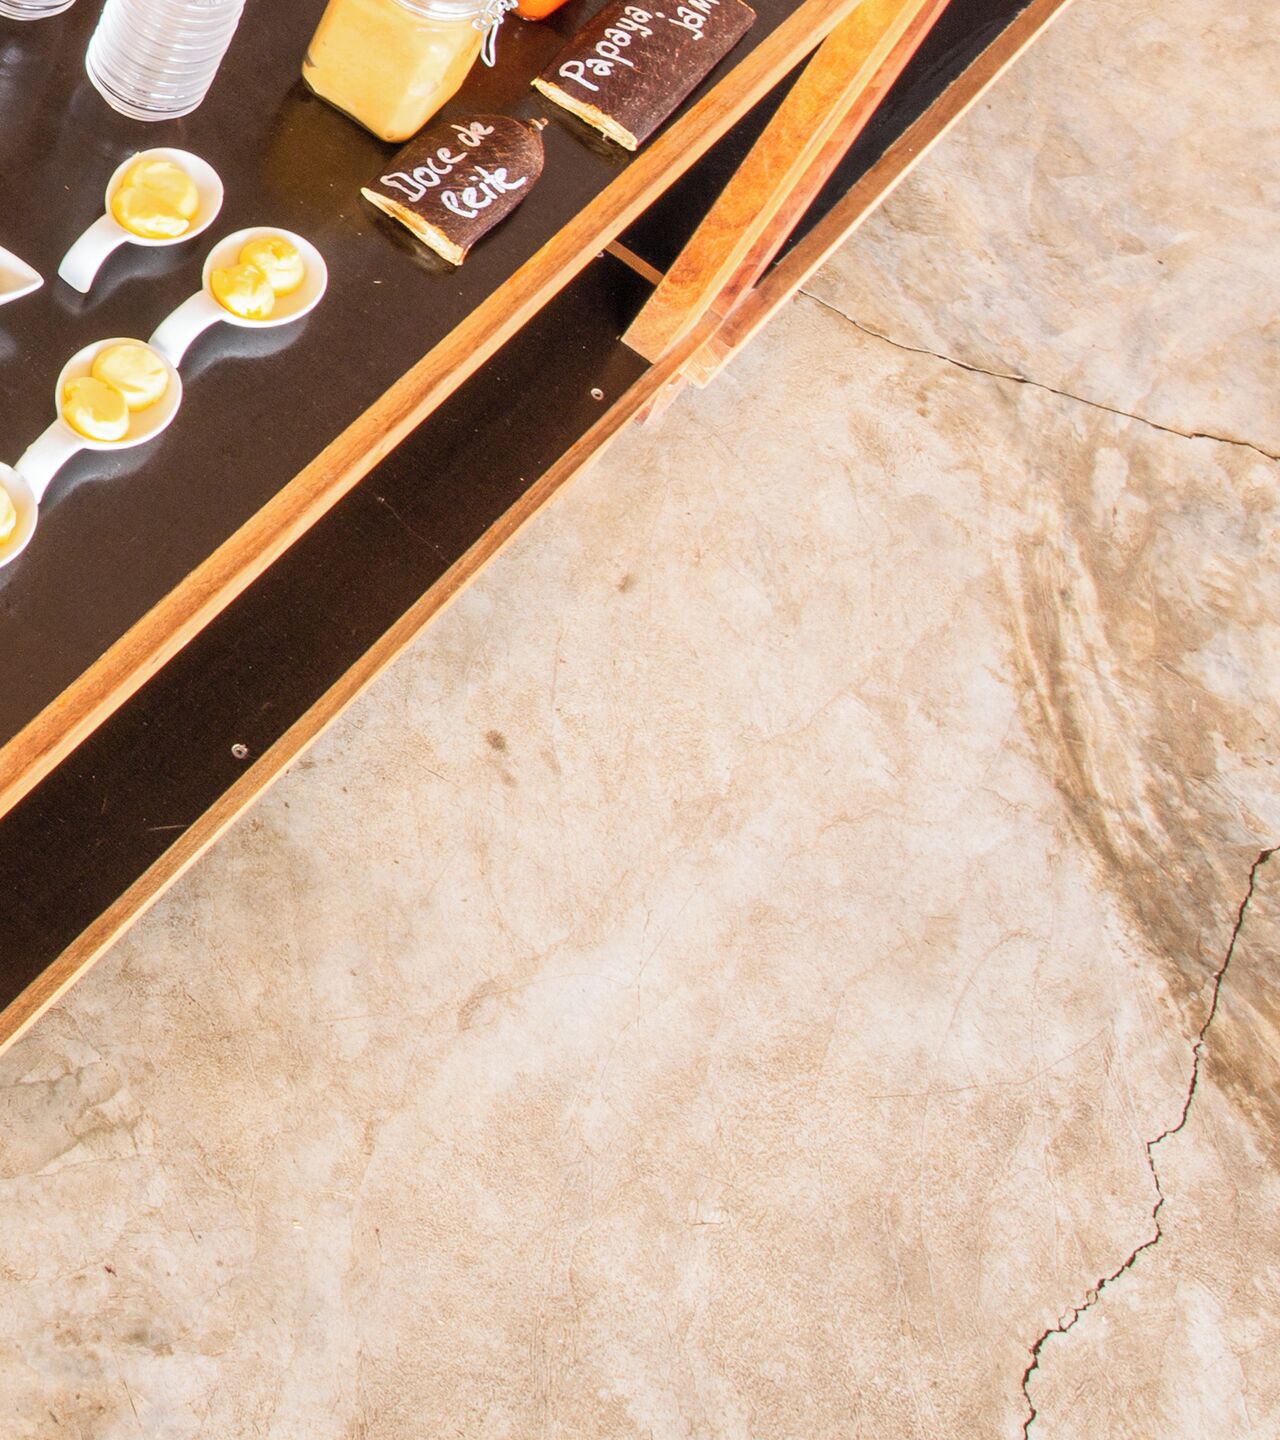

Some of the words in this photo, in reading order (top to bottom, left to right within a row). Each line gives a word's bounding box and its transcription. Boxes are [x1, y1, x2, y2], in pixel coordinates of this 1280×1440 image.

[558, 5, 654, 92] Papaya
[379, 147, 468, 203] Doce
[450, 121, 496, 148] de
